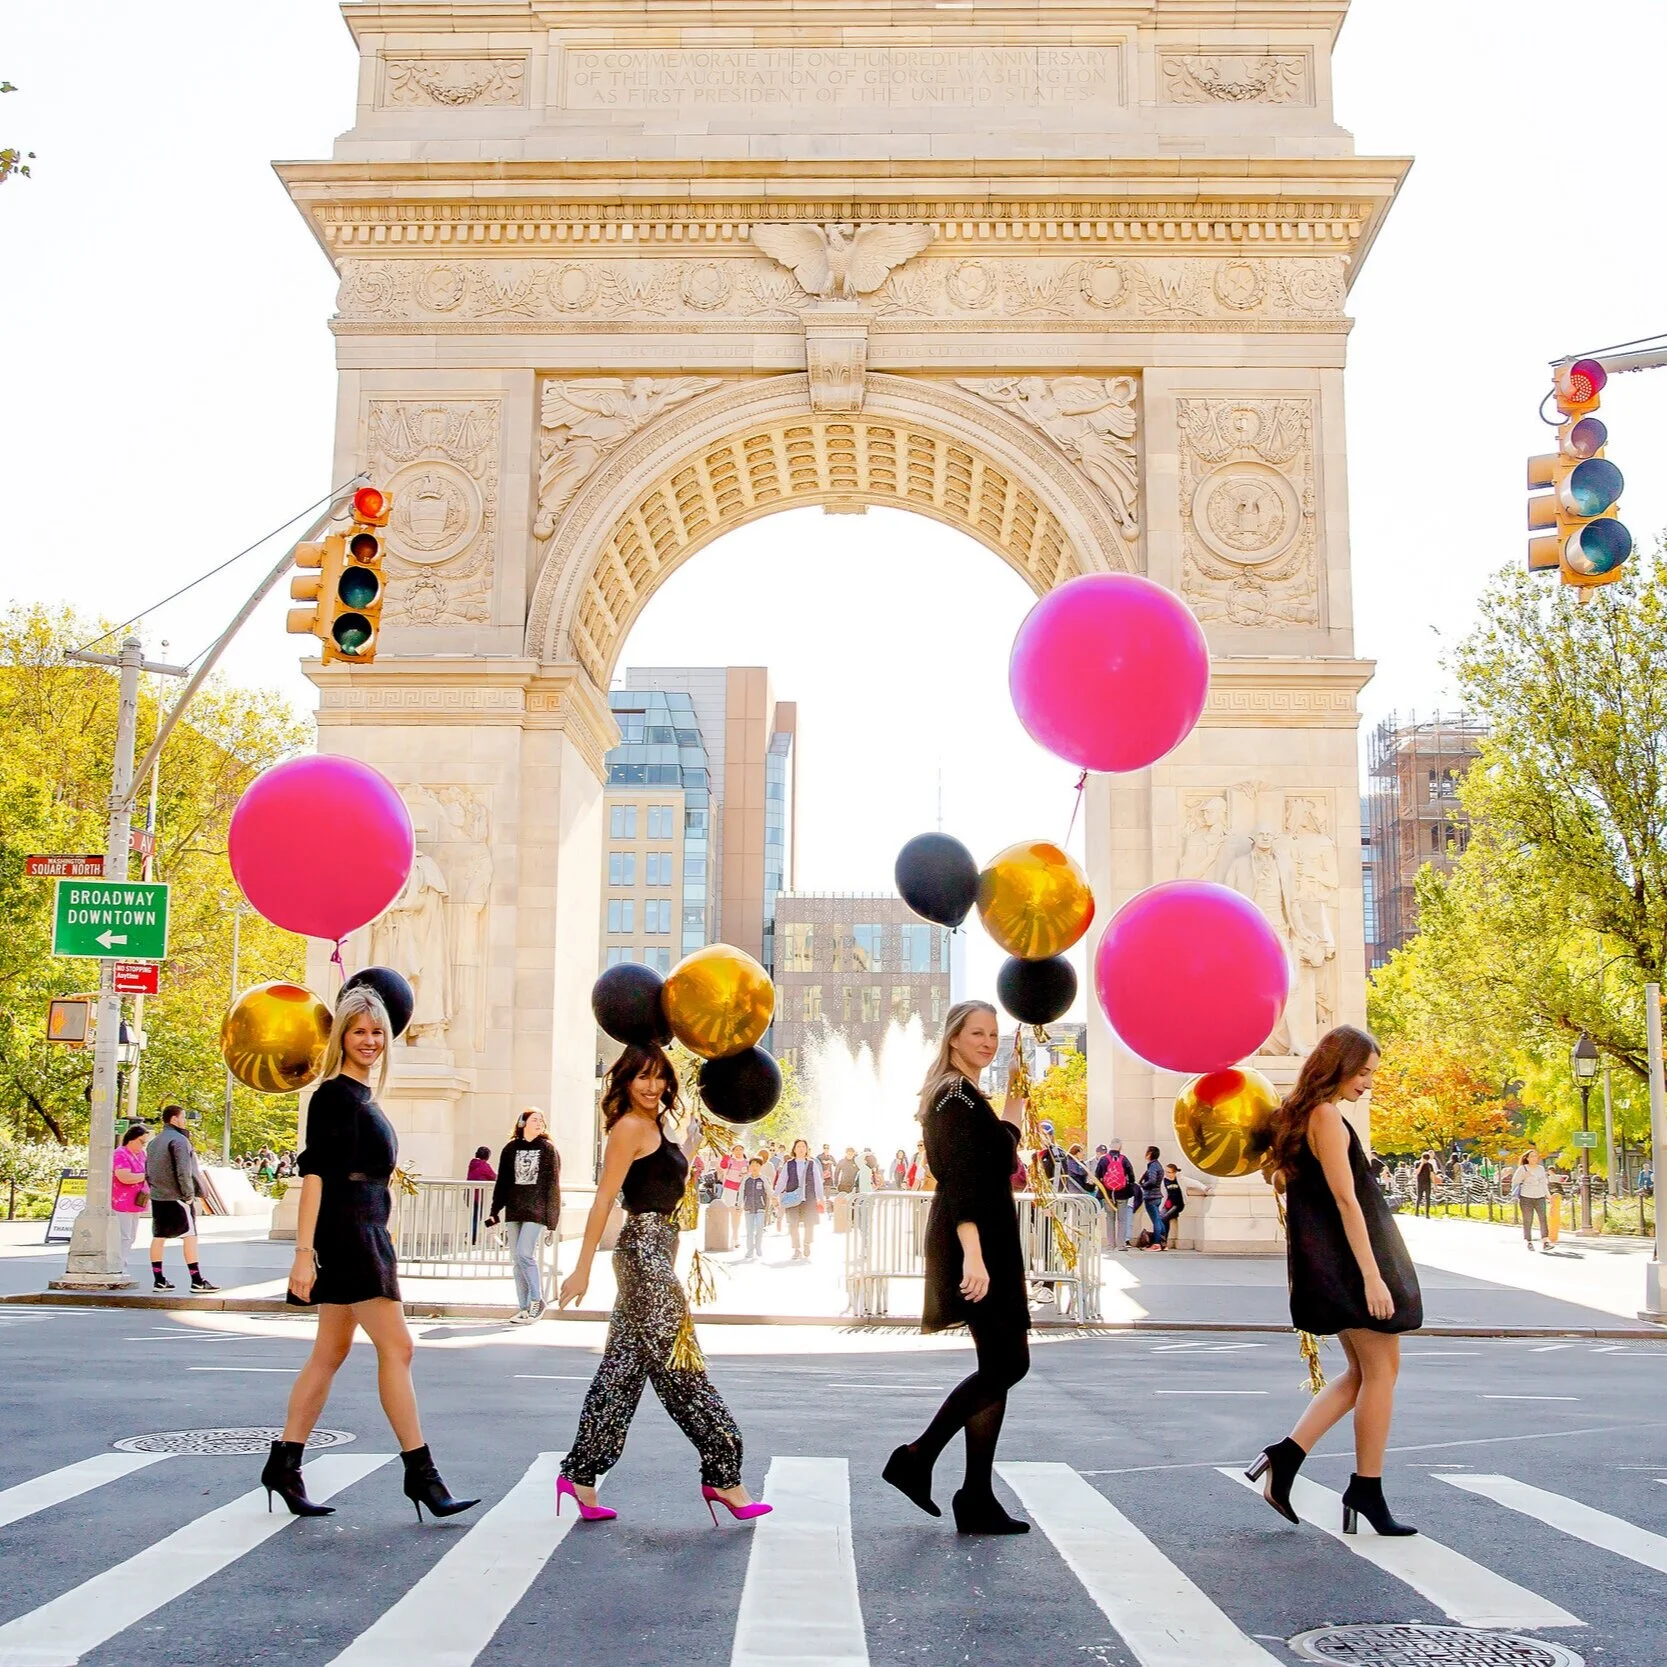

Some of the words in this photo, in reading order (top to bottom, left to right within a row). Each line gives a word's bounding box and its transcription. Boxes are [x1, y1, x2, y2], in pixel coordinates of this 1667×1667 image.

[573, 53, 600, 68] TO
[604, 53, 757, 68] COMMEMORATE
[764, 53, 803, 68] THE
[807, 53, 849, 67] ONE
[853, 52, 972, 67] HUNDREDTH
[974, 51, 1109, 66] ANNIVERSARY
[574, 71, 601, 86] OF
[608, 71, 649, 86] THE
[659, 70, 819, 86] INAUGURATION
[828, 69, 857, 85] OF
[863, 69, 948, 84] GEORGE
[957, 68, 1108, 84] WASHINGTON
[592, 88, 618, 104] AS
[627, 88, 687, 104] FIRST
[693, 88, 809, 104] PRESIDENT
[815, 87, 842, 103] OF
[856, 87, 902, 102] THE
[911, 86, 992, 102] UNITED
[31, 863, 67, 875] SQUARE
[72, 863, 101, 875] NORTH
[70, 890, 155, 906] BROADWAY
[68, 909, 156, 926] DOWNTOWN
[125, 965, 152, 974] STOPPING
